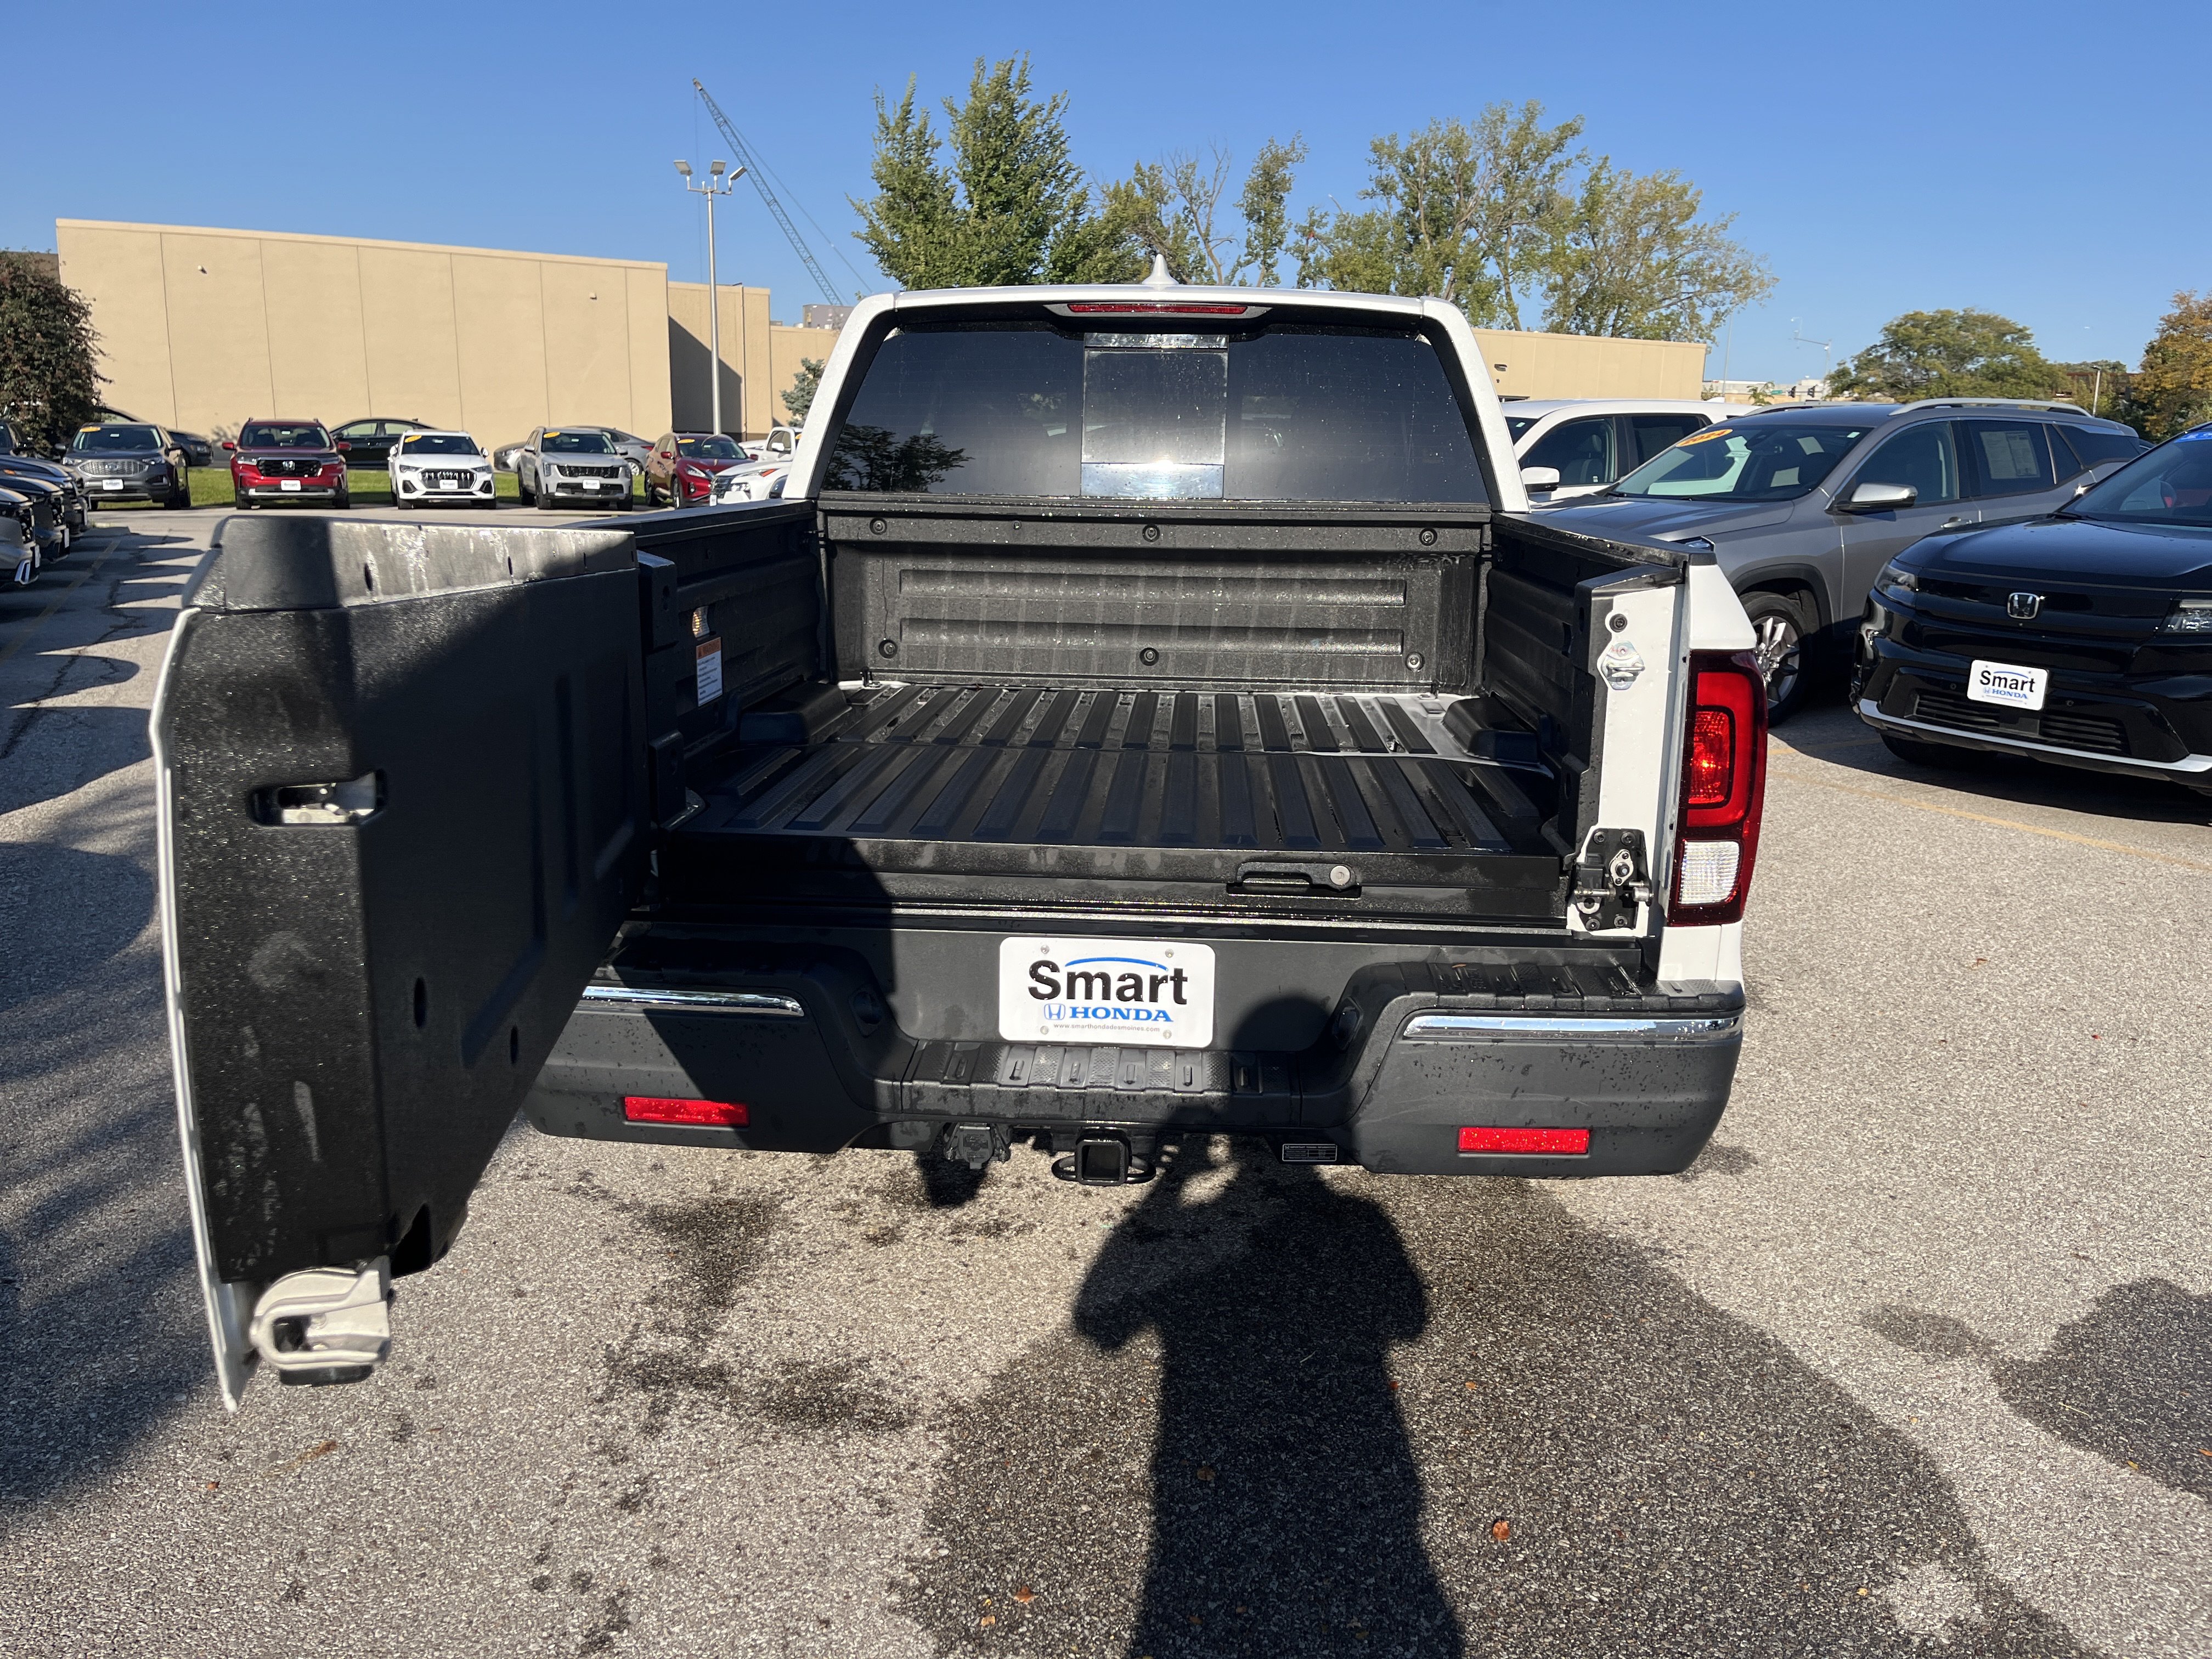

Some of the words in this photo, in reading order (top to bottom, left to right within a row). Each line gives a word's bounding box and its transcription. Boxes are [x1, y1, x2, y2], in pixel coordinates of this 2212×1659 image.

[1979, 670, 2035, 693] Smart
[1992, 689, 2028, 699] HONDA
[1028, 960, 1188, 1005] Smart
[1069, 1006, 1173, 1023] HONDA
[1053, 1023, 1160, 1032] www.smarthondadesmoines.com
